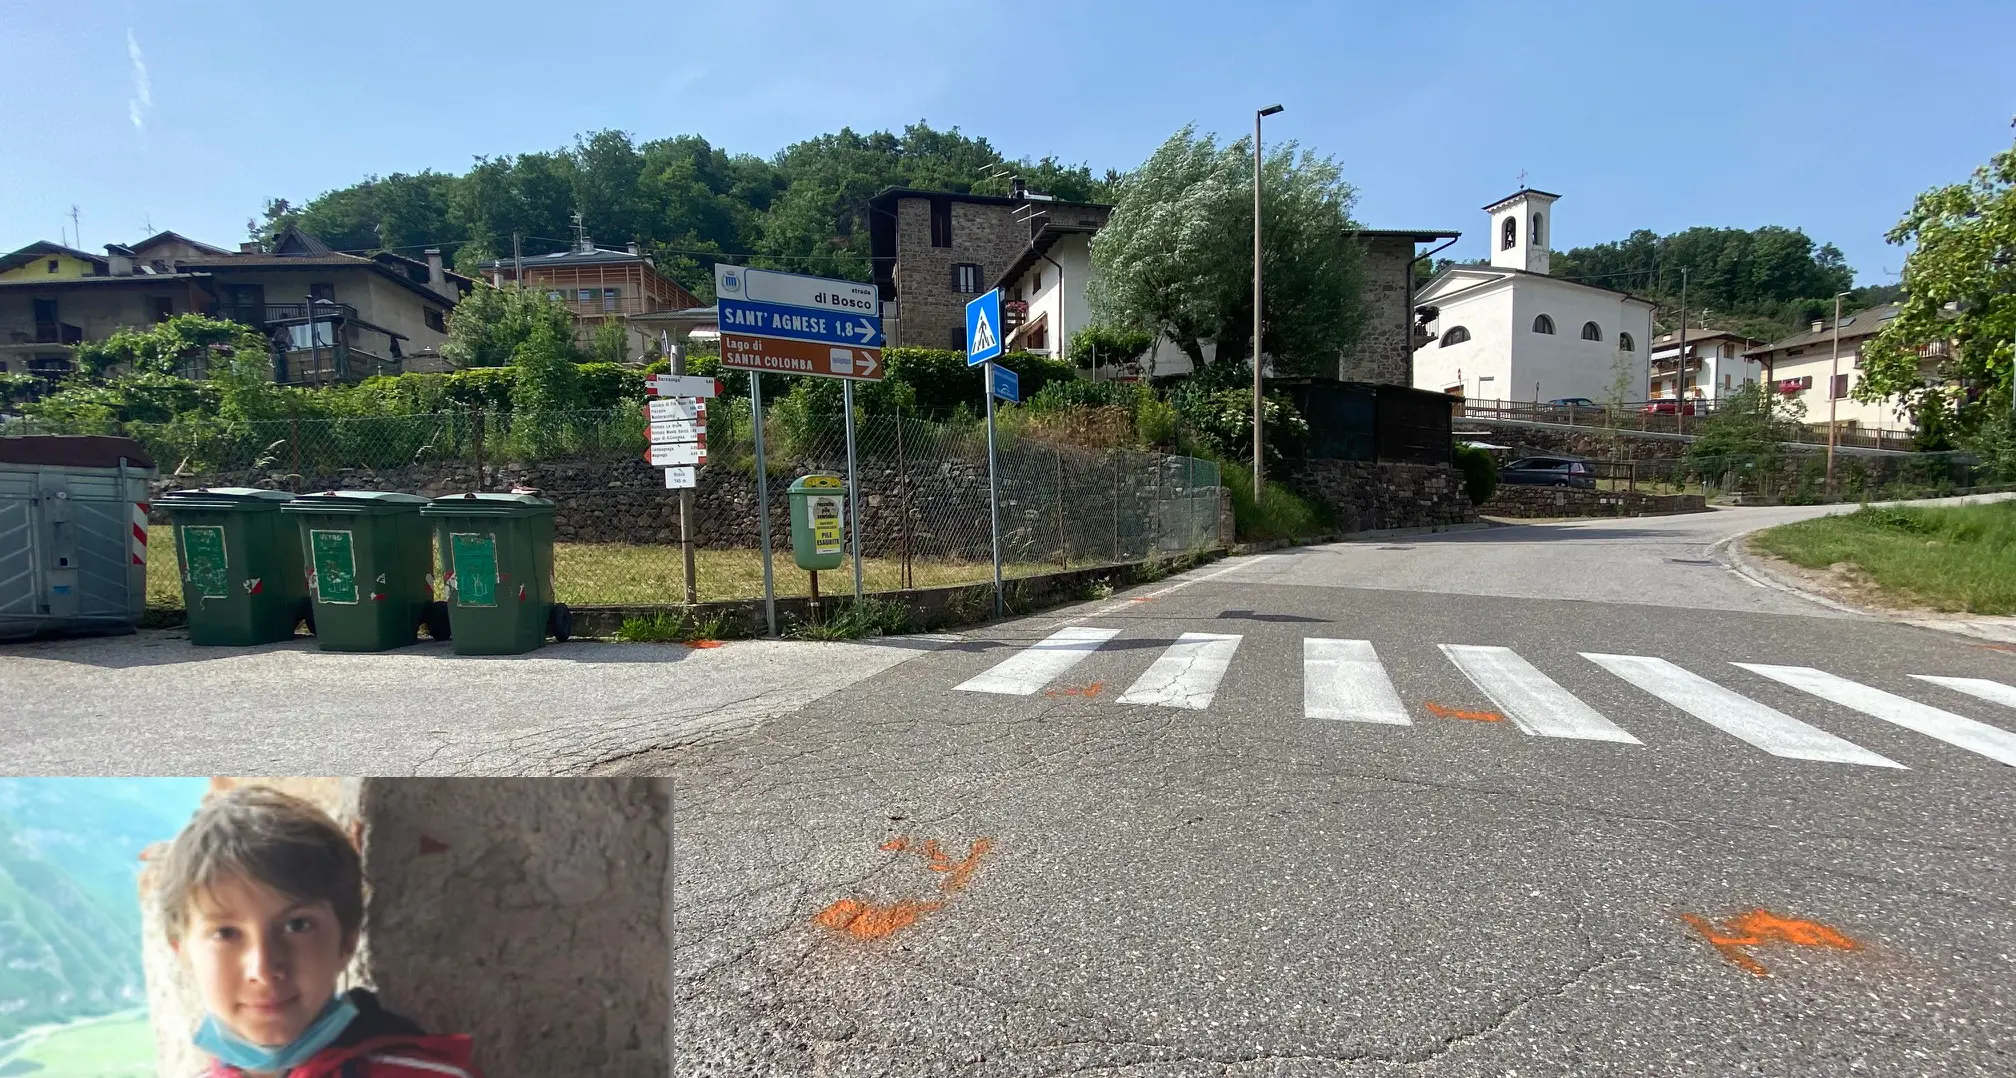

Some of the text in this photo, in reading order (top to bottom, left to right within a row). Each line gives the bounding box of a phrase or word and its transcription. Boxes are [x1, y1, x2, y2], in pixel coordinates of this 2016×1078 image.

[852, 288, 871, 296] strada
[814, 292, 872, 310] di Bosco
[725, 308, 768, 326] SANT'
[772, 314, 826, 334] AGNESE
[726, 338, 762, 351] Lago di
[727, 354, 813, 370] SANTA COLOMBA
